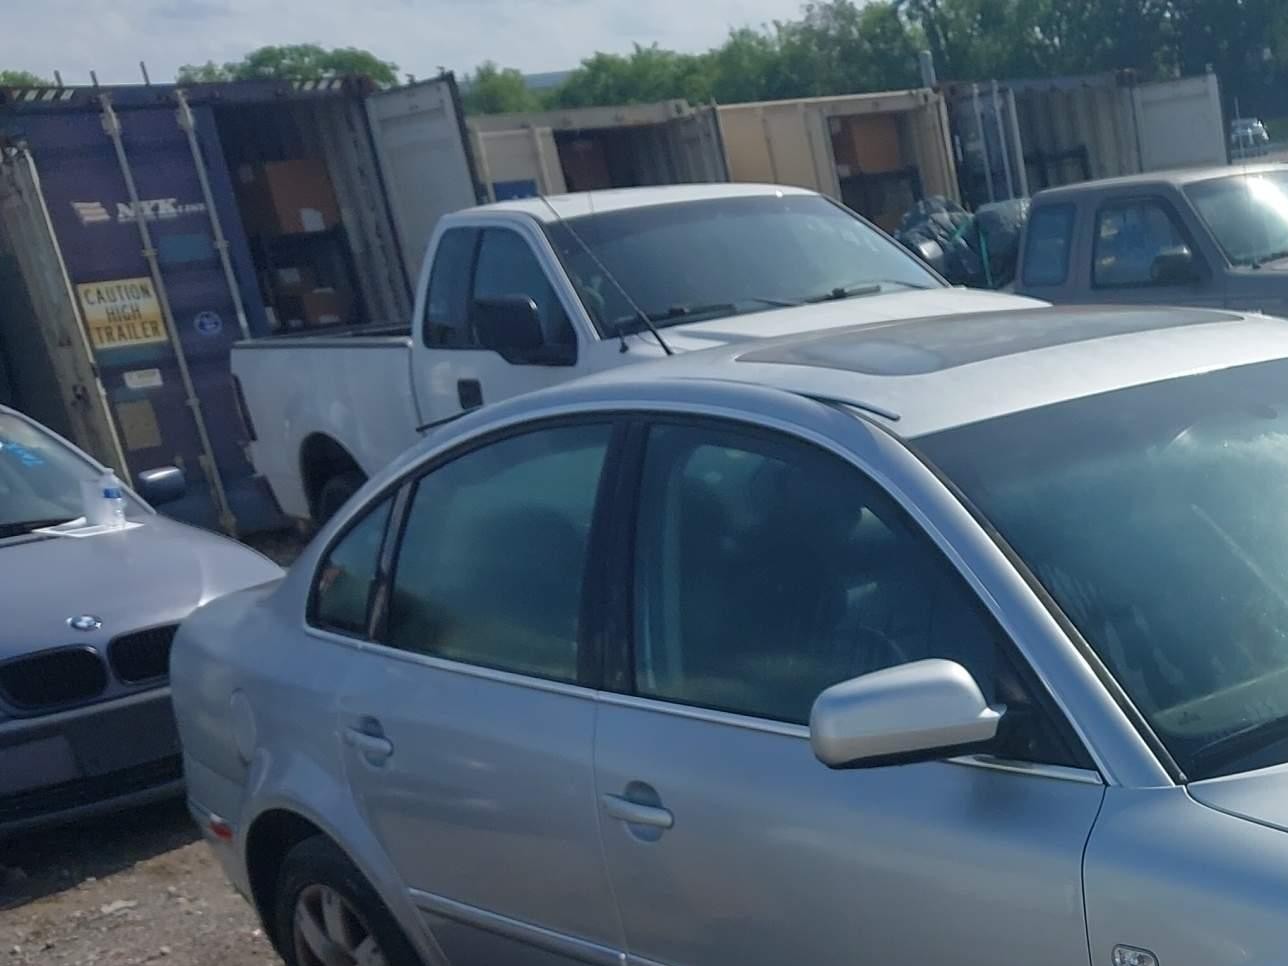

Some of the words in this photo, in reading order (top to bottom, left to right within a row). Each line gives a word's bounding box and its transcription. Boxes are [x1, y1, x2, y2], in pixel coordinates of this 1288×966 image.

[116, 198, 177, 222] NYK
[83, 283, 152, 305] CAUTION
[105, 302, 142, 322] HIGH
[95, 320, 161, 344] TRAILER
